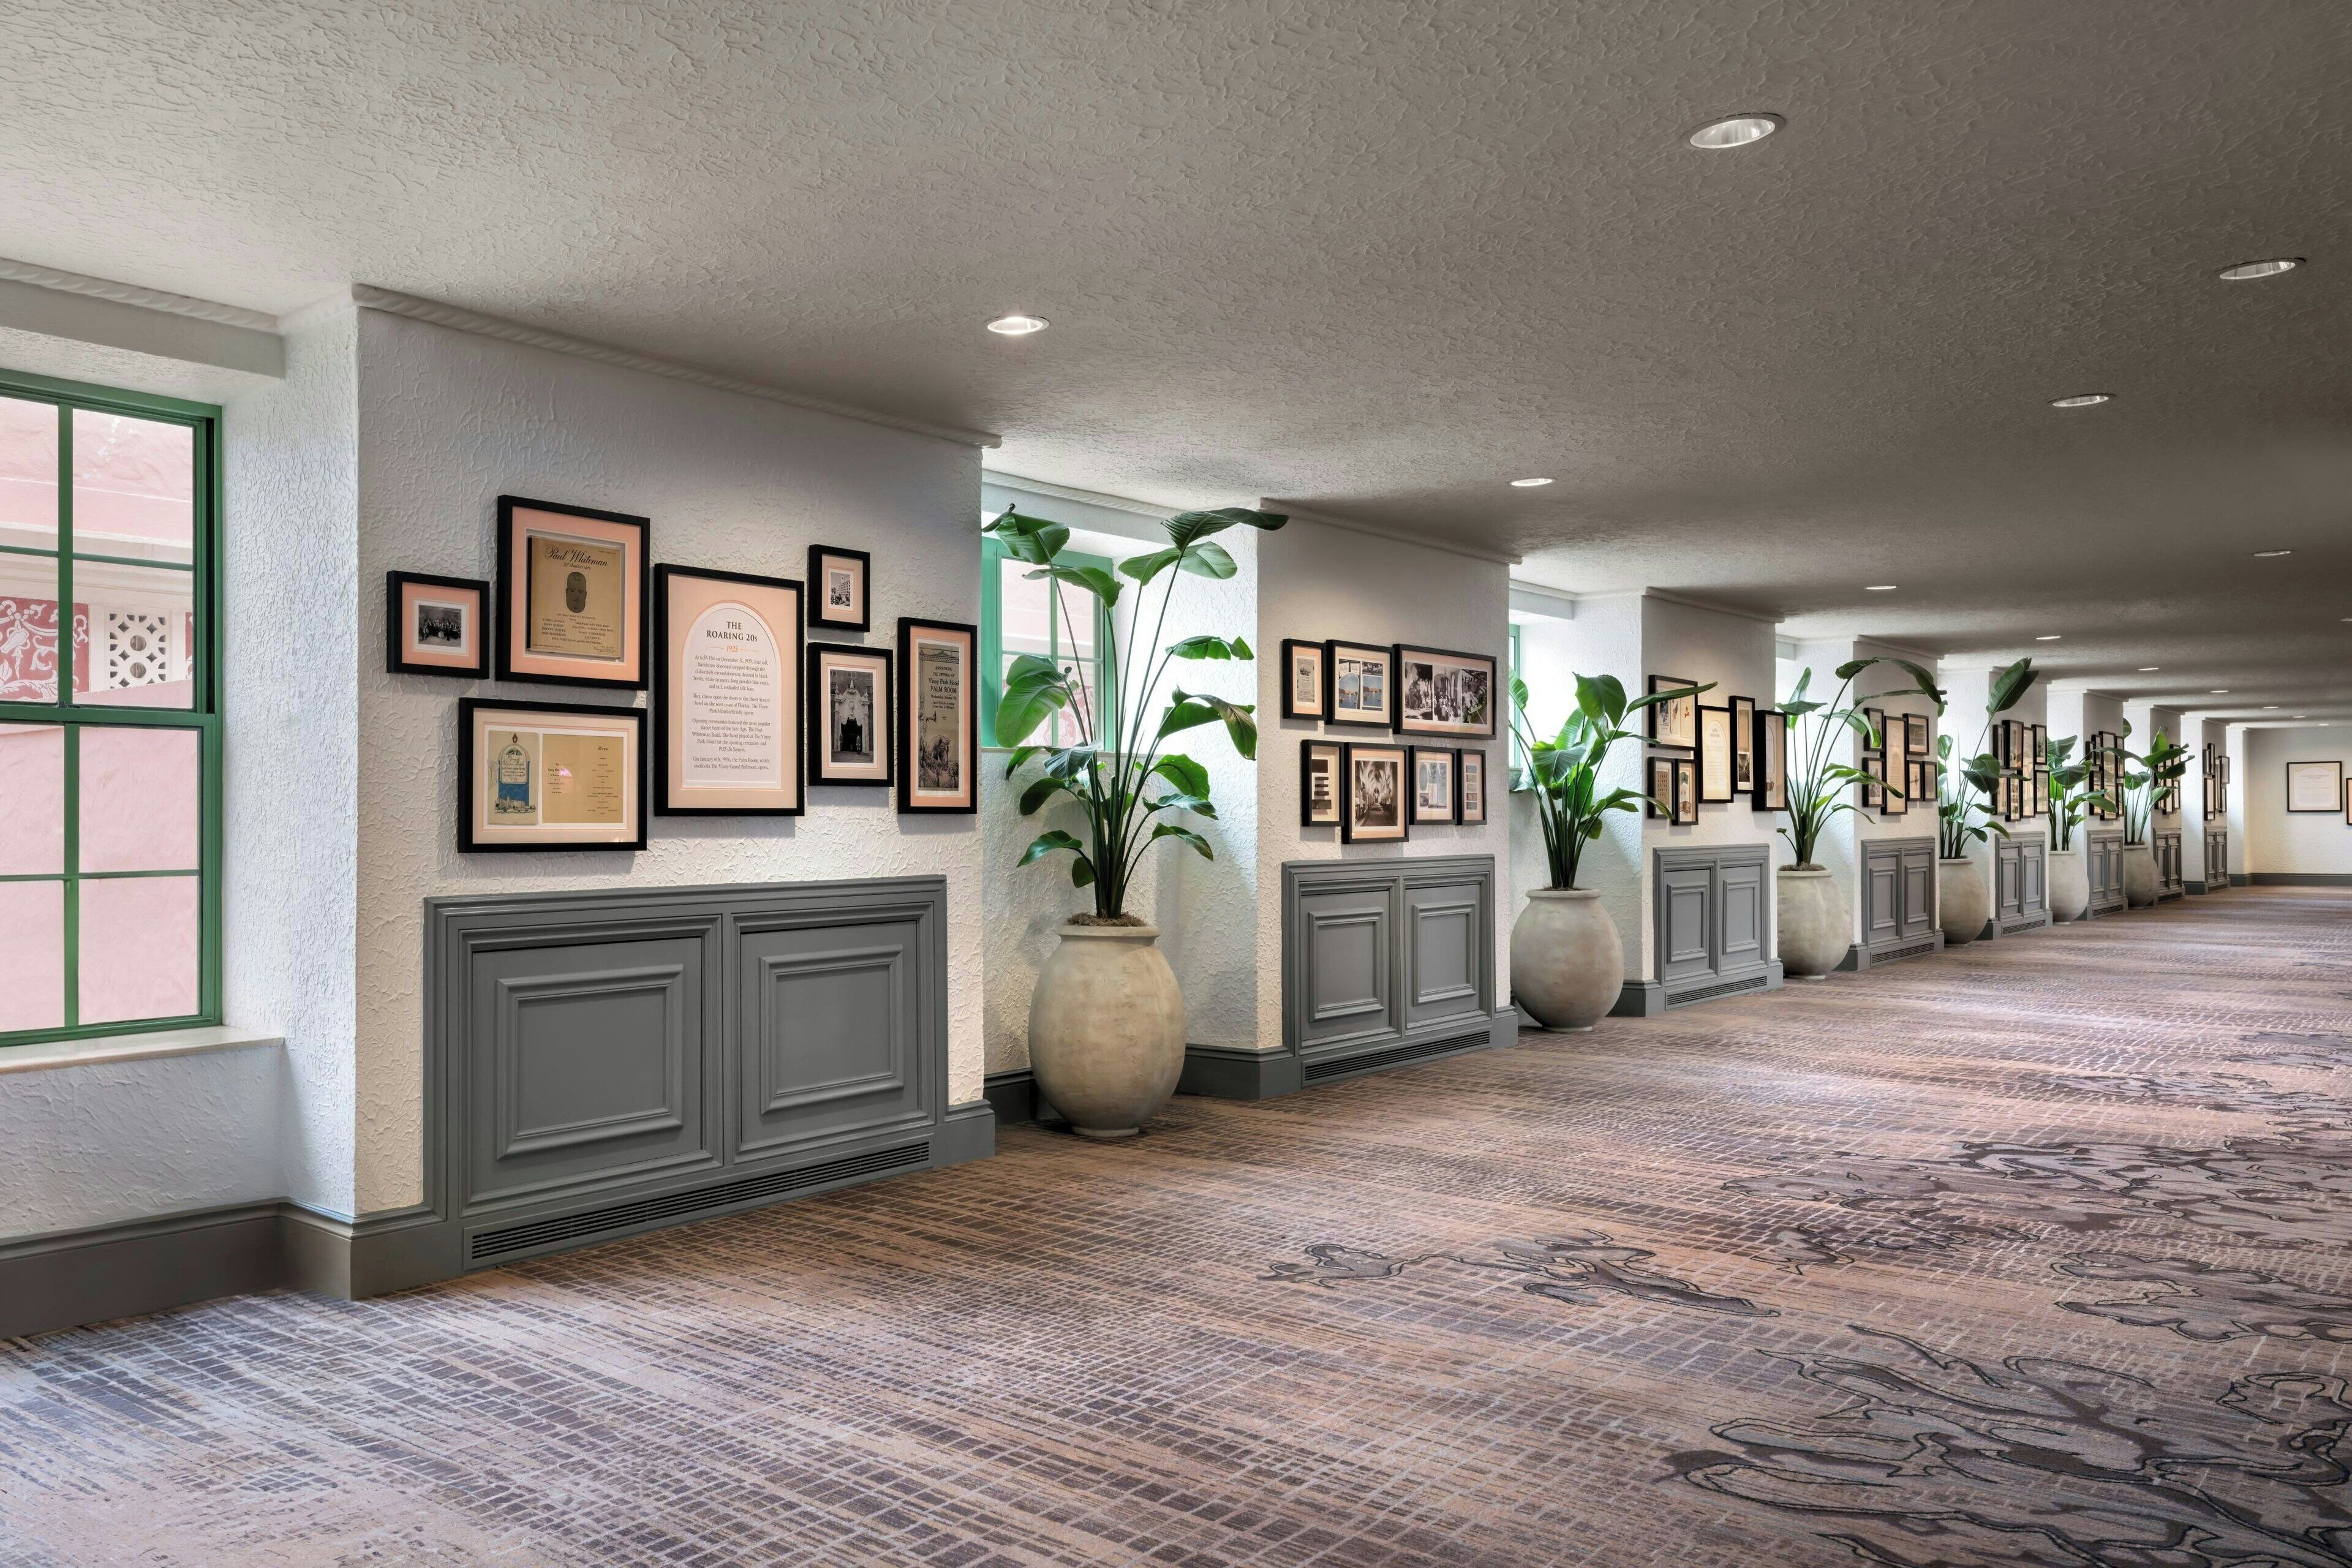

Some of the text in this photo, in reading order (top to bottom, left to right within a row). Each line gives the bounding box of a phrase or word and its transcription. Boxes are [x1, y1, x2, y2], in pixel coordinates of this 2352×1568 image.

[545, 544, 608, 566] Paul Whiteman
[726, 621, 742, 630] THE
[707, 630, 743, 640] ROARING
